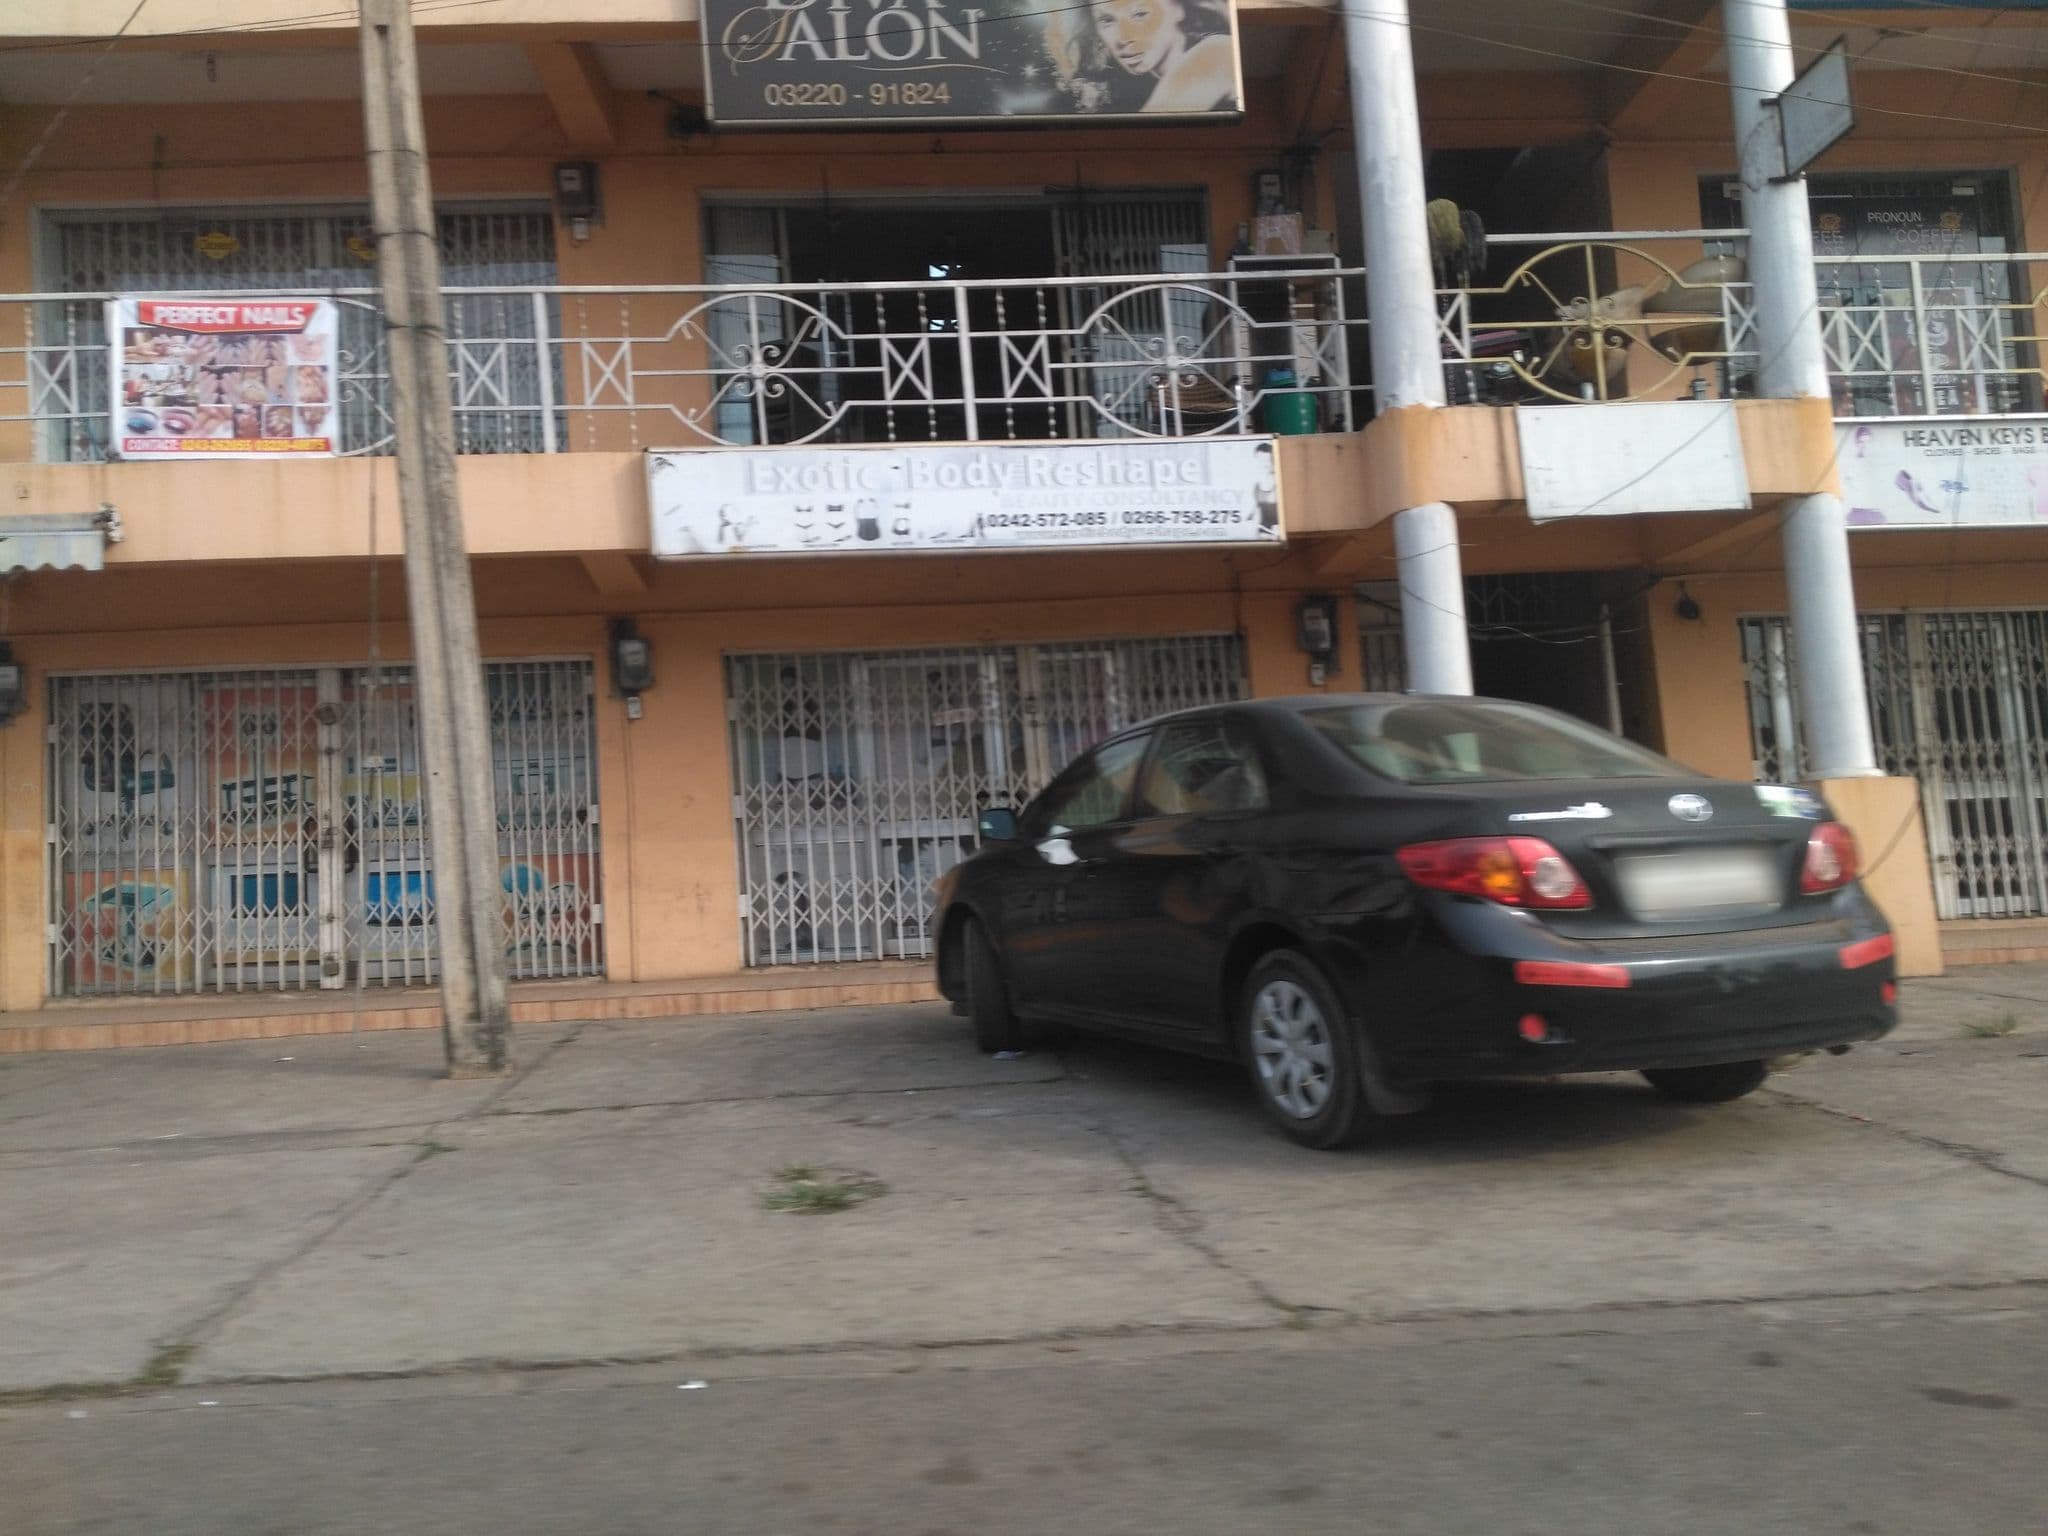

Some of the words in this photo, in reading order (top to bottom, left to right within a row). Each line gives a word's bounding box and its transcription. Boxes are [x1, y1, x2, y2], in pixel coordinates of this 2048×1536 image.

[722, 4, 986, 64] SALON
[764, 83, 847, 106] 03220
[869, 82, 952, 105] 91824
[1867, 211, 1922, 223] PRONOUN
[152, 306, 239, 323] PERFECT
[242, 306, 305, 325] NAILS
[1903, 428, 1983, 446] HEAVEN
[1988, 427, 2035, 445] KEYS
[746, 455, 876, 494] Exotic
[906, 451, 1014, 489] Body
[987, 512, 1107, 528] 0242-572-085
[1121, 510, 1241, 525] 0266-758-275
